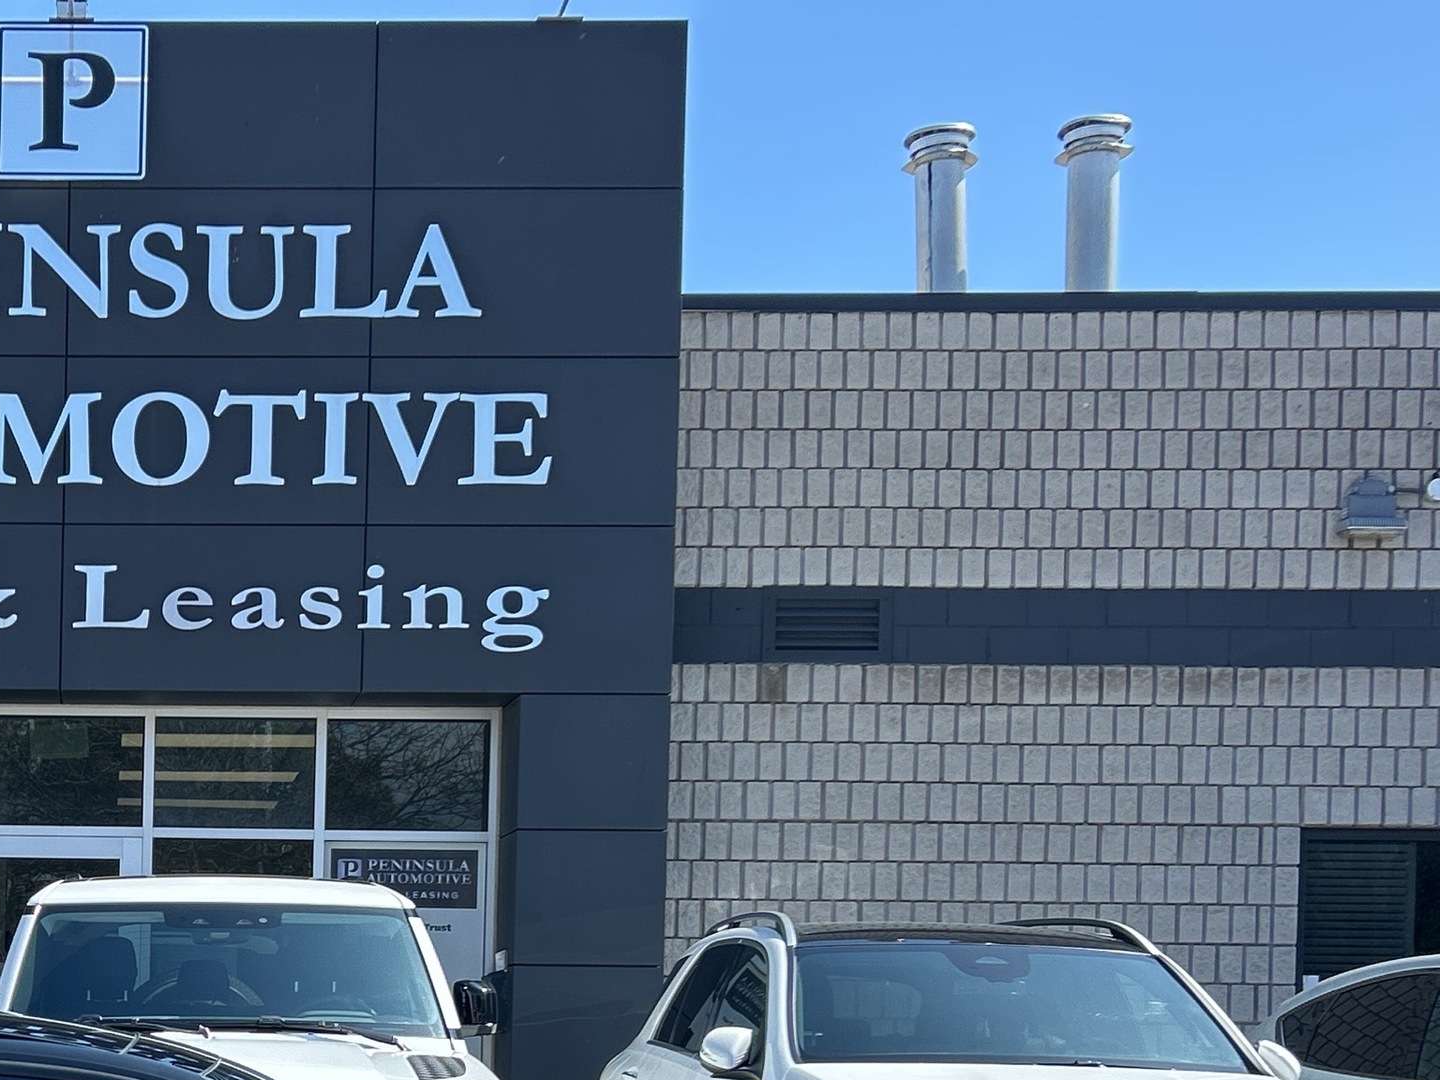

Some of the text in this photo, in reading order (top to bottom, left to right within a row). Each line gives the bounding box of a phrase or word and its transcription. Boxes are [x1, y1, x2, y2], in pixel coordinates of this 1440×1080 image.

[27, 52, 115, 152] P
[72, 564, 549, 653] Leasing
[342, 861, 359, 880] P
[367, 859, 470, 873] PENINSULA
[367, 873, 472, 885] AUTOMOTIVE
